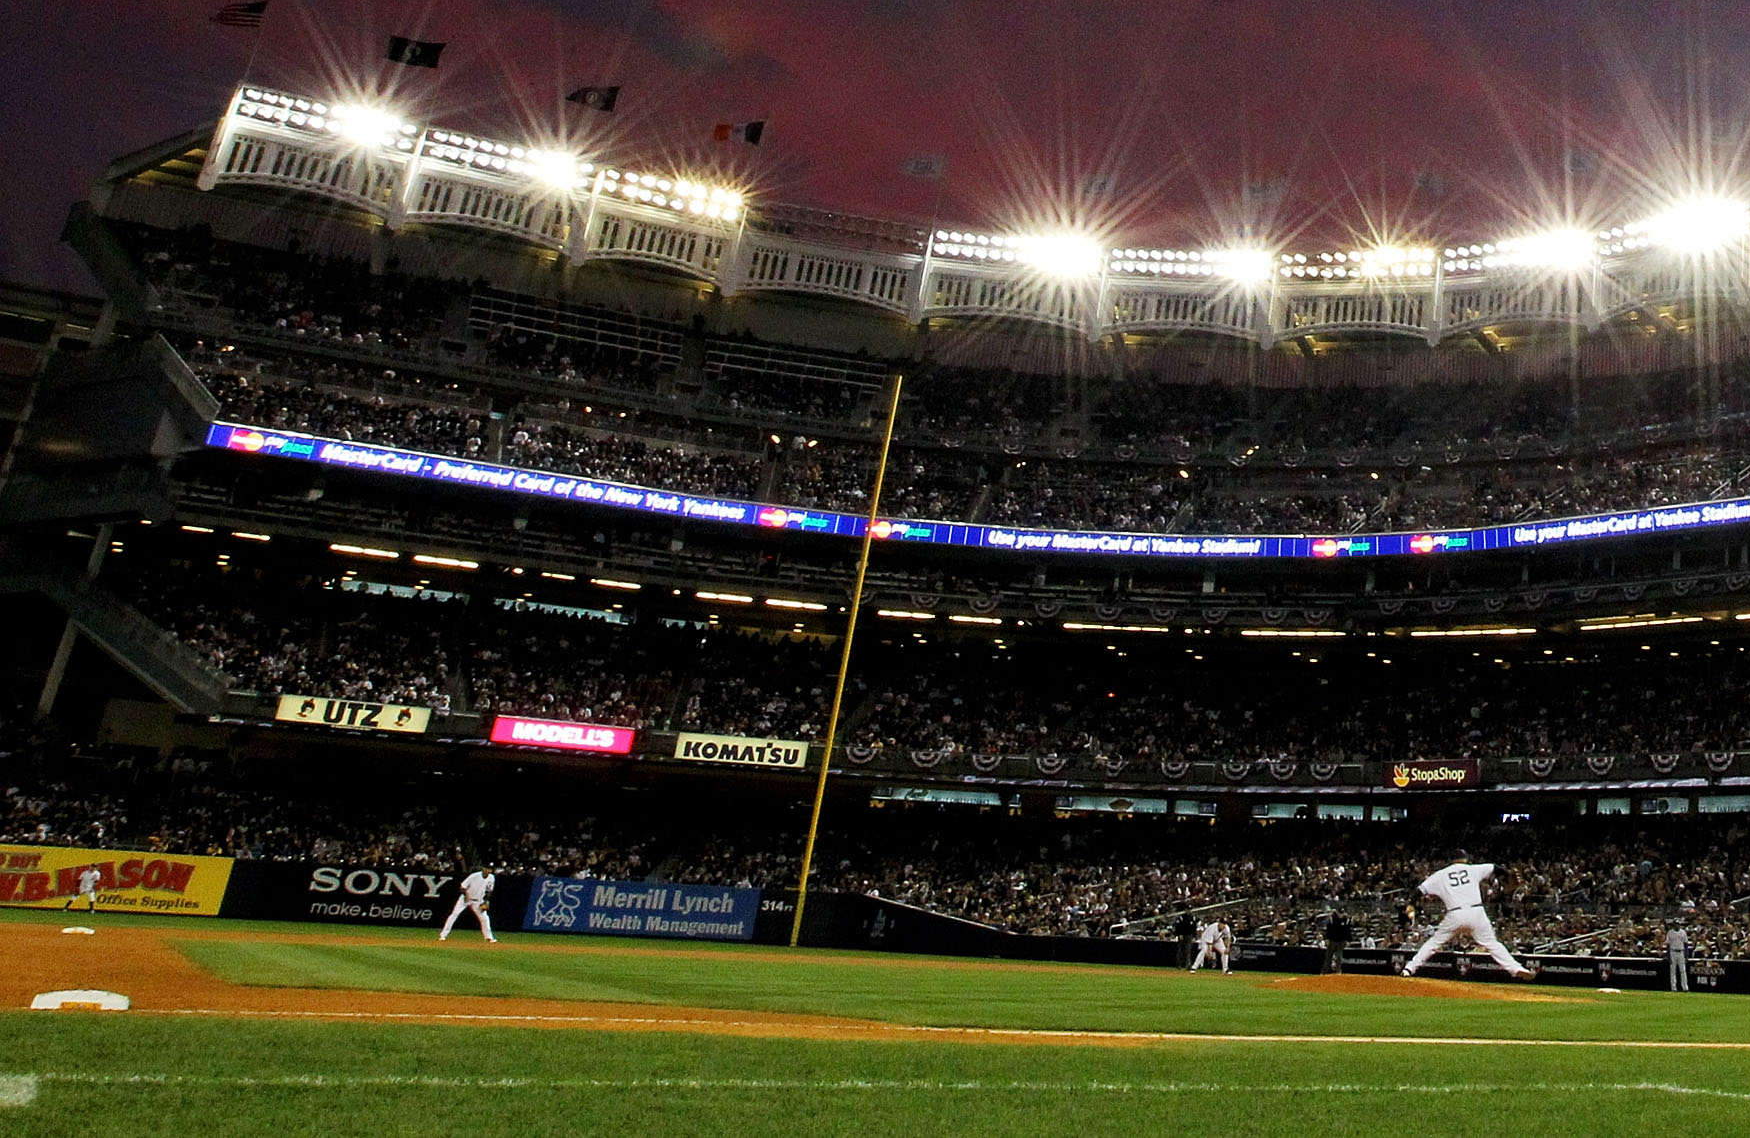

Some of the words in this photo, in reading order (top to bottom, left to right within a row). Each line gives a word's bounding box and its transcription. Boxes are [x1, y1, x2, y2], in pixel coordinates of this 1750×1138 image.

[320, 443, 423, 473] MasterCard
[432, 461, 512, 487] Preferred
[514, 473, 555, 493] Card
[554, 478, 576, 499] of
[575, 480, 603, 500] the
[604, 486, 644, 507] New
[644, 491, 681, 512] York
[681, 497, 746, 521] Yankees
[1514, 527, 1536, 543] Use
[1536, 525, 1566, 543] your
[1567, 514, 1637, 538] MasterCard
[1637, 513, 1652, 530] at
[1653, 509, 1700, 528] Yankee
[988, 530, 1015, 546] Use
[1015, 533, 1051, 550] your
[1051, 534, 1132, 552] MasterCard
[1132, 537, 1149, 552] at
[1150, 538, 1200, 554] Yankee
[1200, 538, 1261, 555] Stadium!
[323, 699, 384, 728] UTZ
[511, 721, 615, 748] MODELL'S
[682, 741, 799, 765] KOMATSU
[1411, 767, 1466, 784] Stop&Shop
[308, 867, 453, 898] SONY
[1448, 869, 1470, 887] 52
[96, 893, 136, 906] Office
[141, 896, 199, 910] Supplies
[310, 902, 433, 920] make.believe
[593, 885, 667, 911] Merrill
[672, 889, 734, 913] Lynch
[588, 913, 642, 930] Wealth
[645, 915, 744, 936] Management
